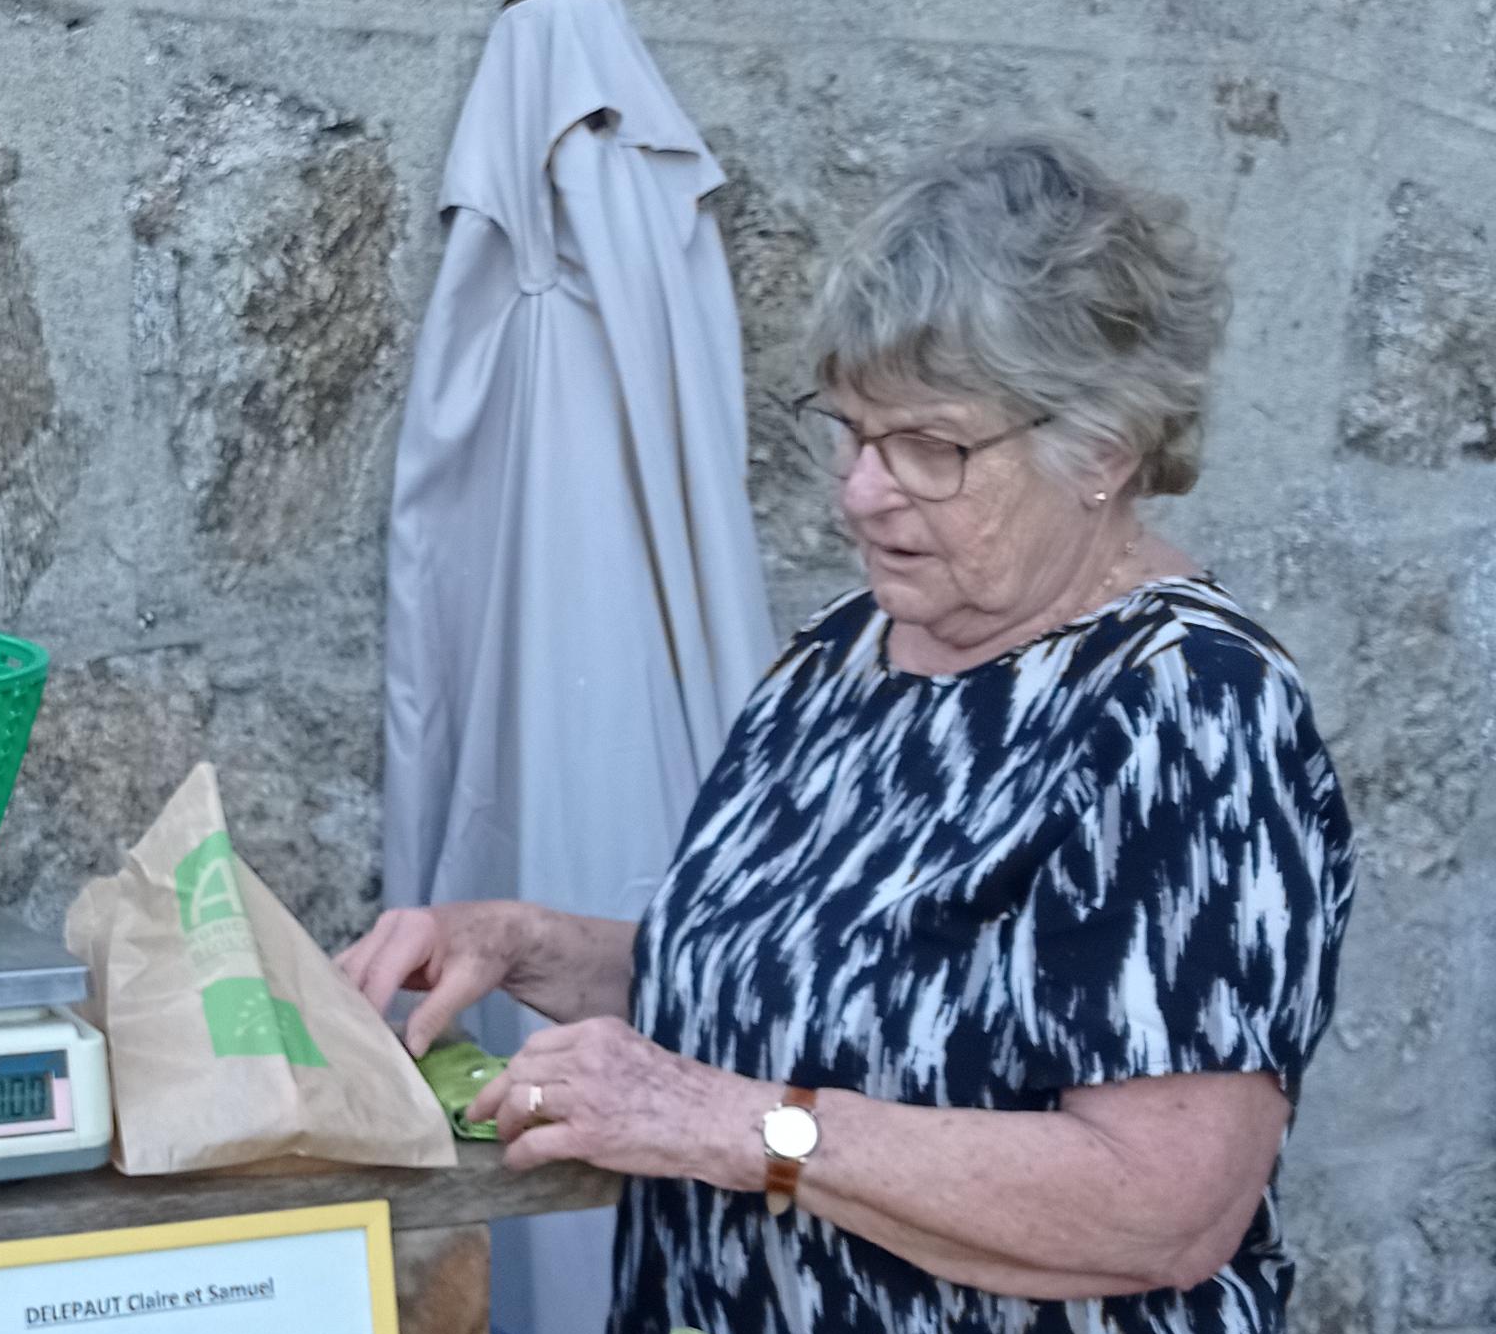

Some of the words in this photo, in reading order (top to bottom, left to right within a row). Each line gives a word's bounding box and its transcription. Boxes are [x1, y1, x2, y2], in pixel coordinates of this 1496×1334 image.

[25, 1296, 123, 1326] DELEPAUT
[128, 1289, 179, 1313] Claire
[184, 1286, 203, 1306] et
[207, 1277, 275, 1302] Samuel
